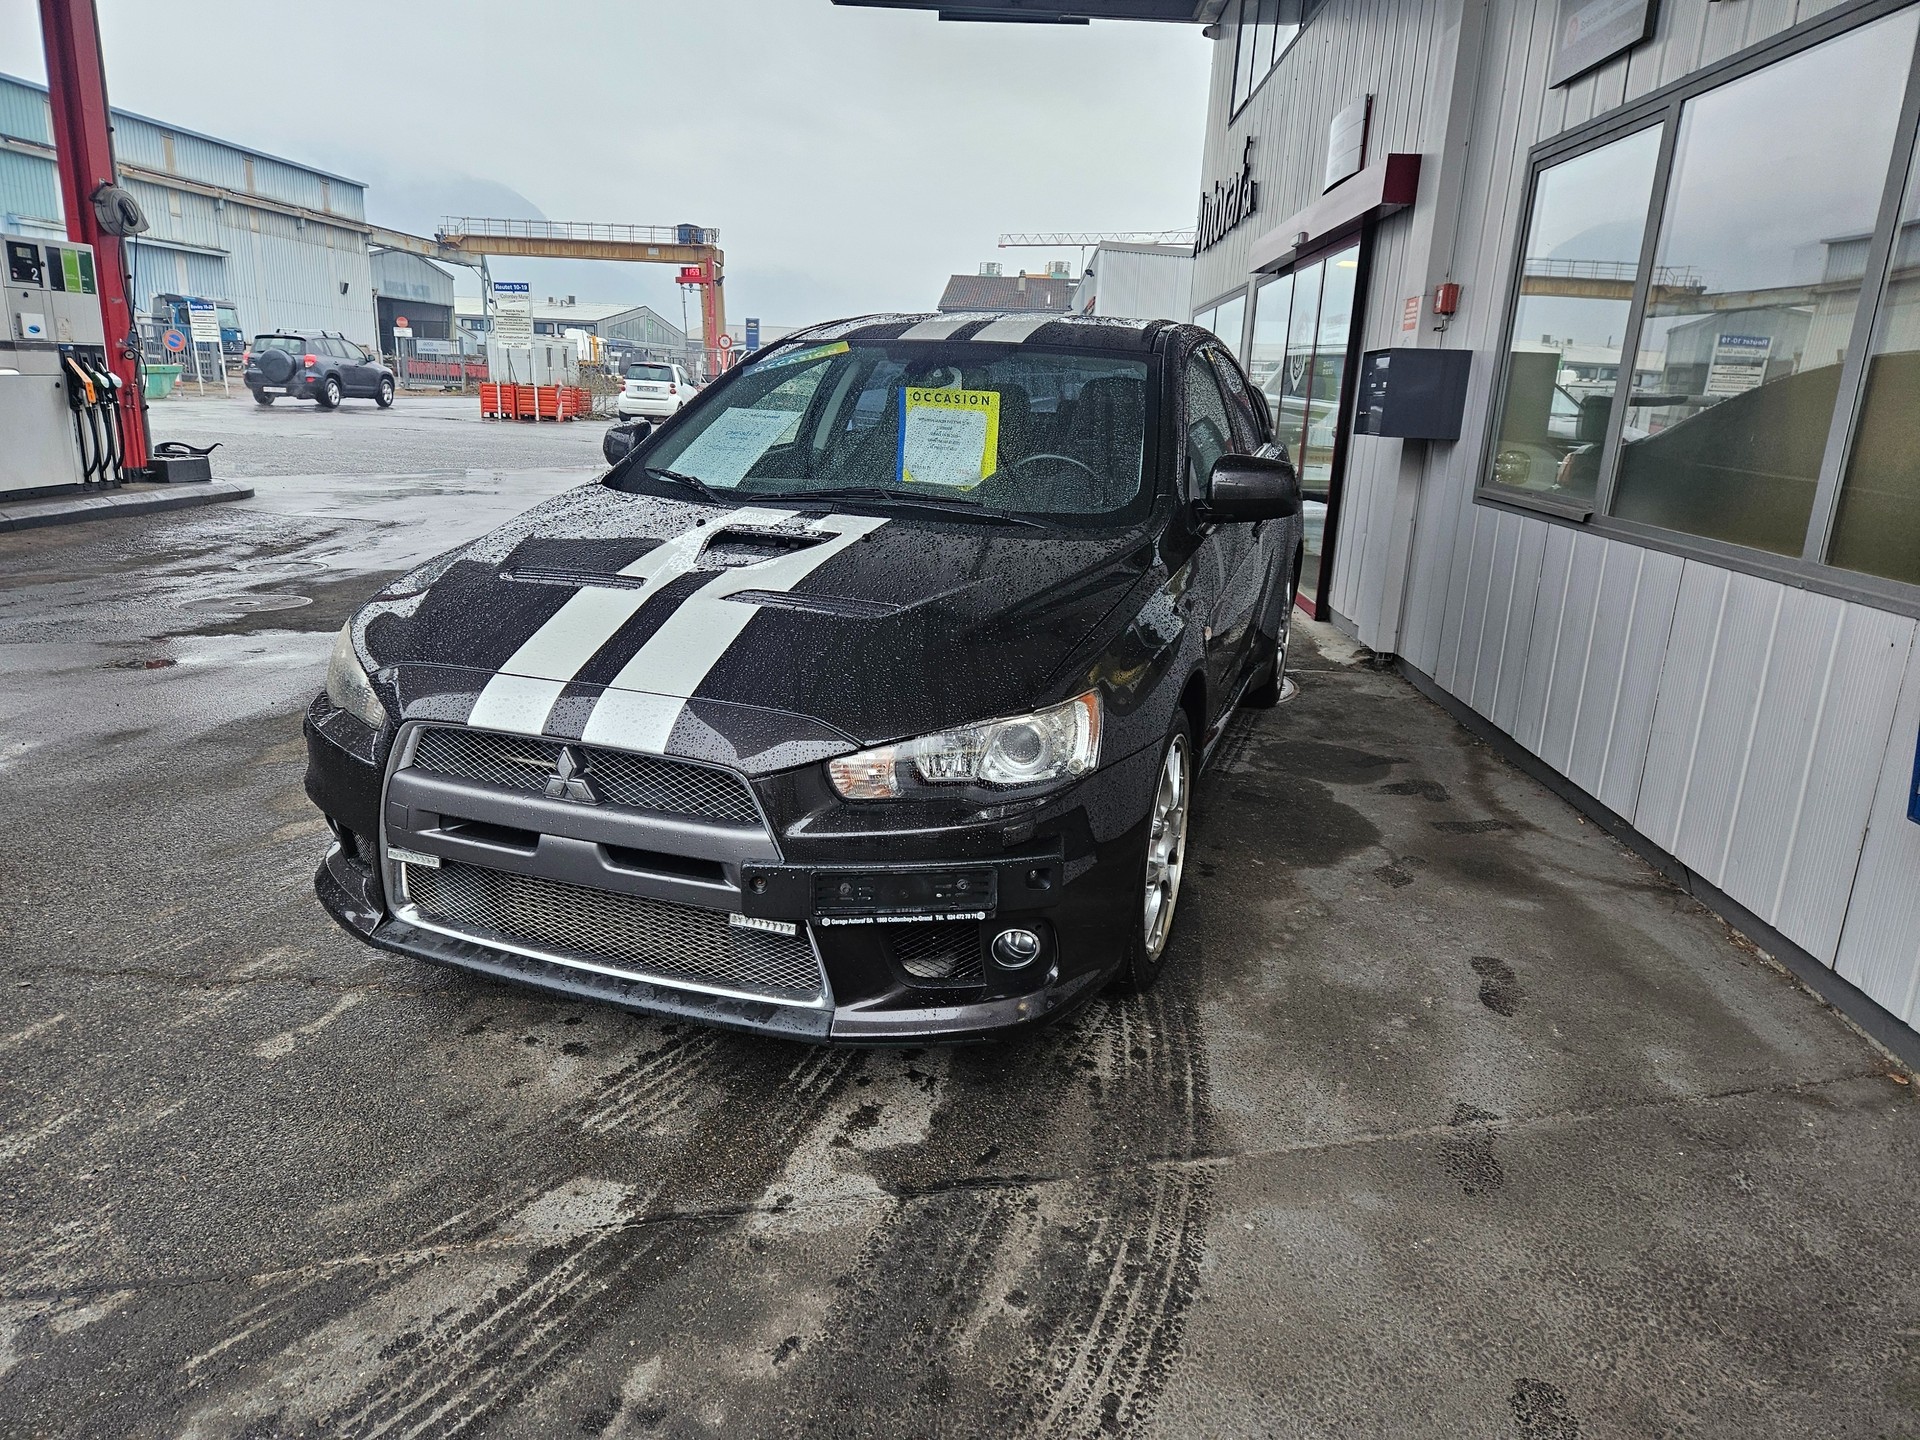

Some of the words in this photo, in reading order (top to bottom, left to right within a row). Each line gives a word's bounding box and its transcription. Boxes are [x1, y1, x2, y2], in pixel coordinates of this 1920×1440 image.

[31, 267, 40, 281] 2
[754, 349, 837, 372] OCCASION
[912, 391, 990, 406] OCCASION
